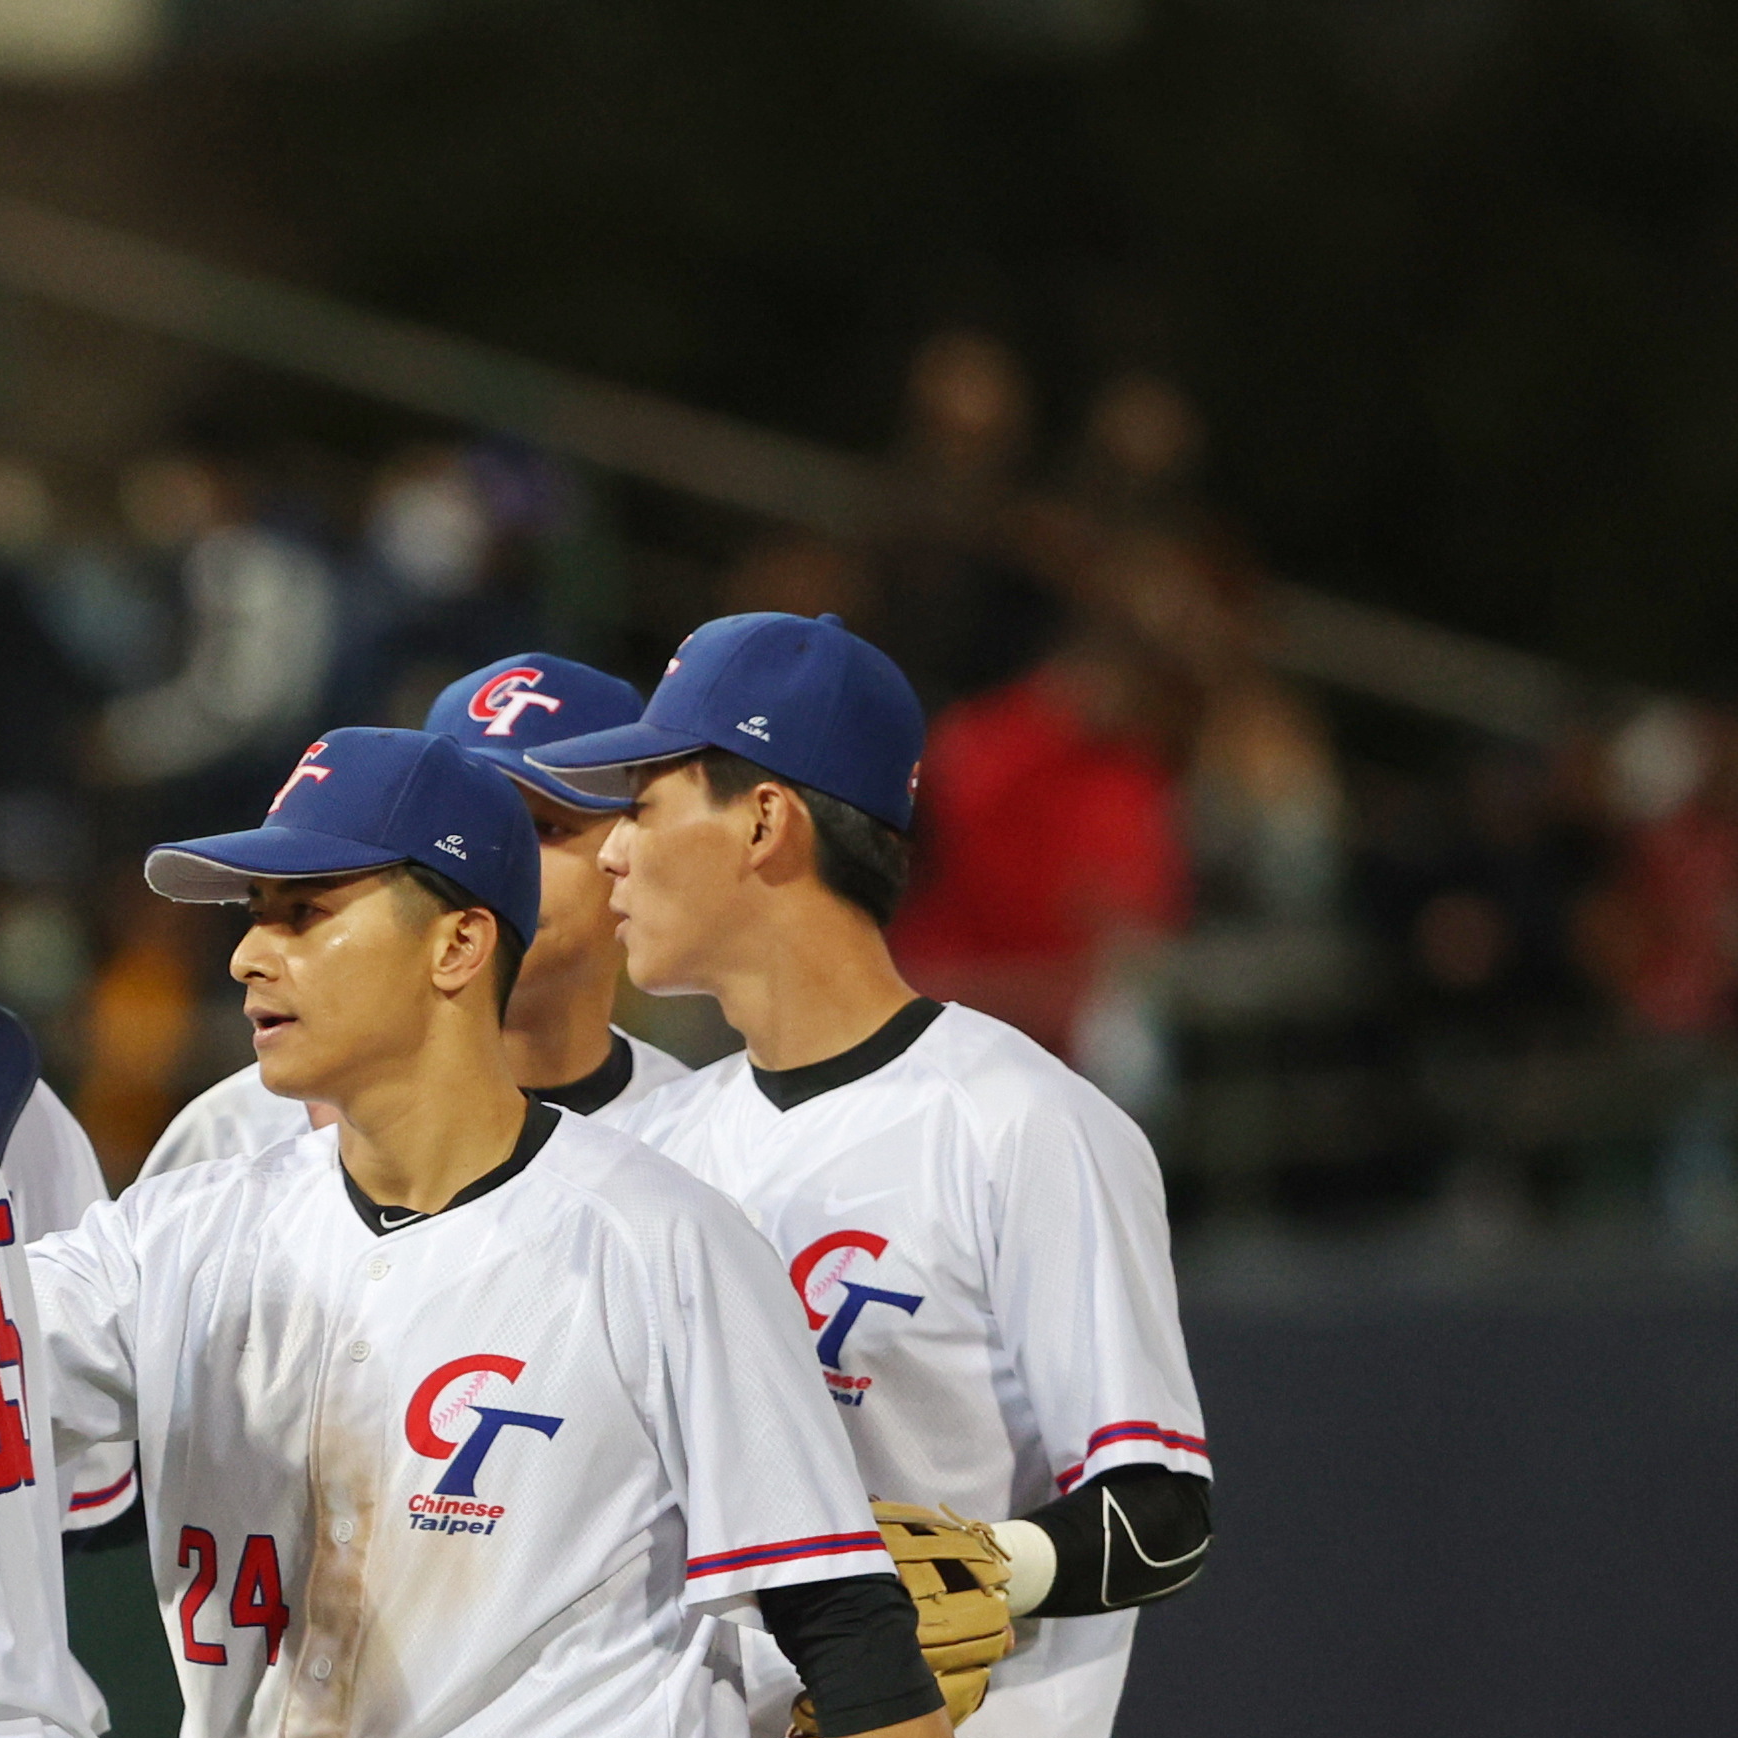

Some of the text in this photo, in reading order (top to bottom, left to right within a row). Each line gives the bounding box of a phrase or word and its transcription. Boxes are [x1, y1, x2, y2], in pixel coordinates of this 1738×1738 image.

[404, 1352, 566, 1499] CT
[407, 1493, 506, 1520] Chinese
[409, 1512, 499, 1536] Taipei
[177, 1523, 291, 1668] 24
